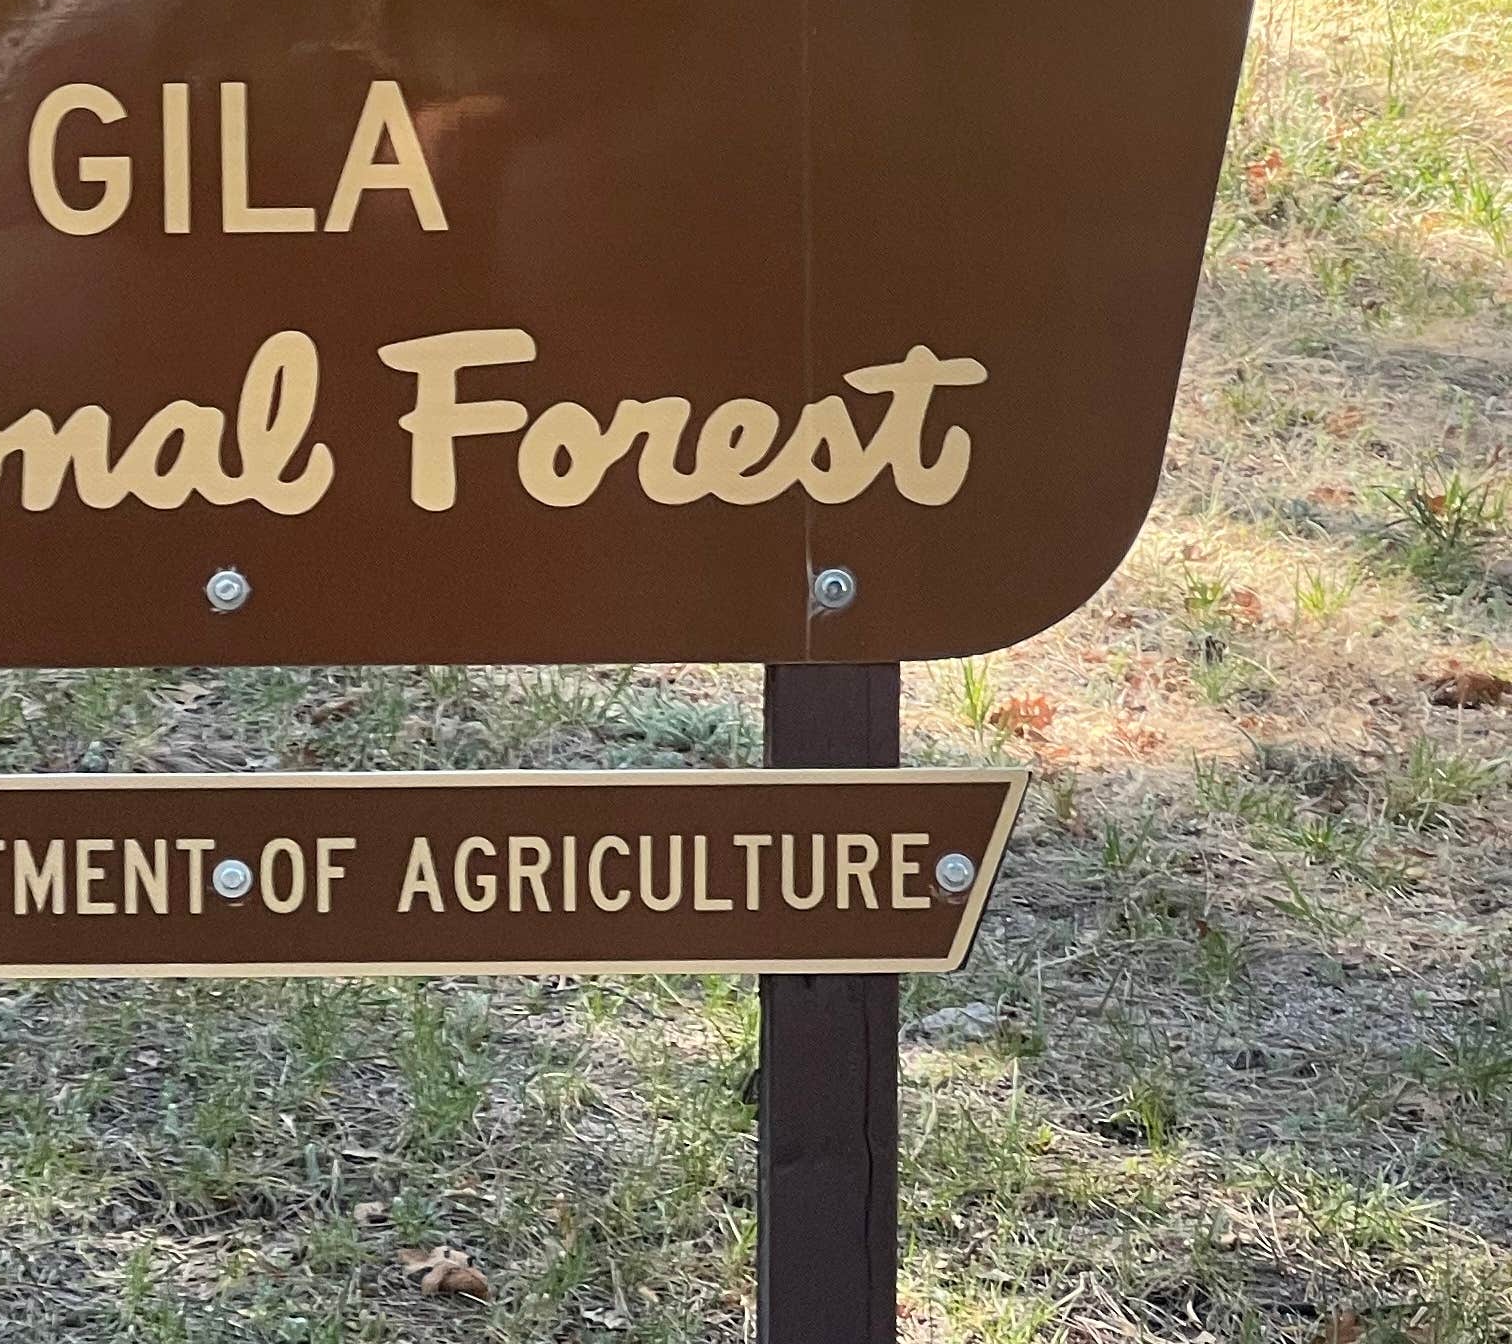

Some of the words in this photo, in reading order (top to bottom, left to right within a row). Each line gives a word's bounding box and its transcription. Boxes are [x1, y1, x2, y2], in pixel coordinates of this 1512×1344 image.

[26, 79, 450, 236] GILA
[378, 327, 987, 512] Forest
[259, 836, 356, 914] OF
[398, 831, 932, 913] AGRICULTURE
